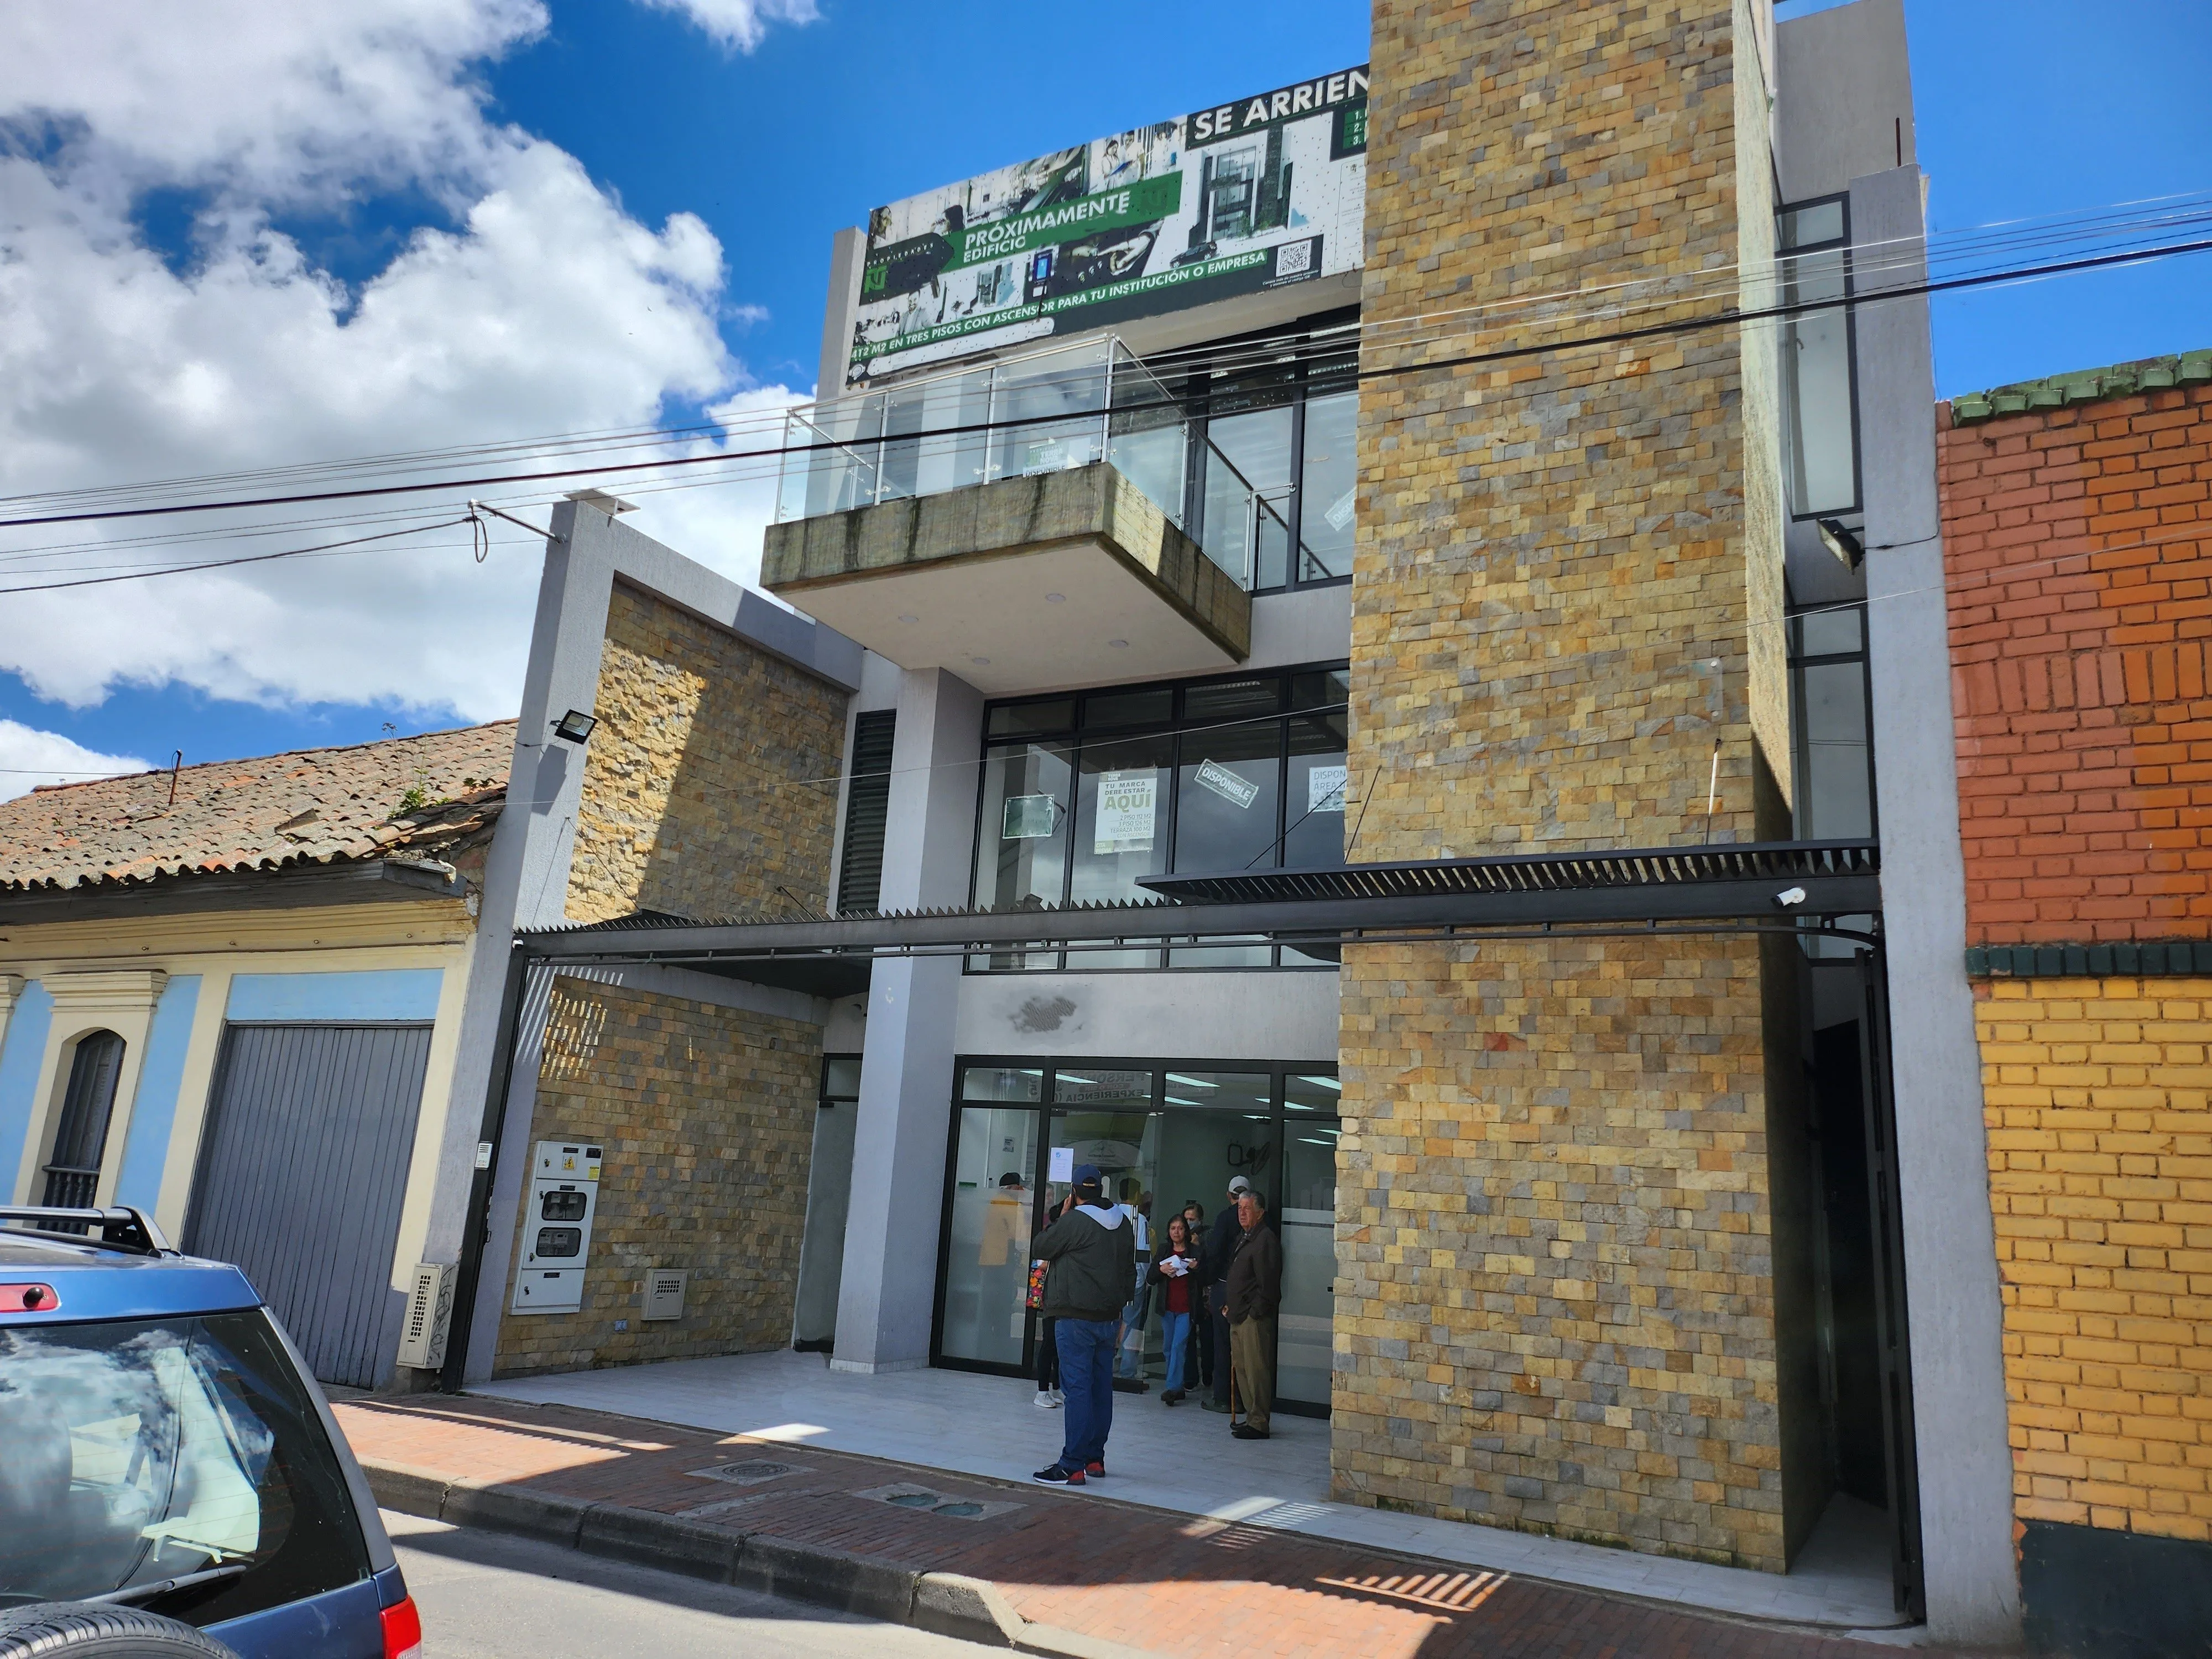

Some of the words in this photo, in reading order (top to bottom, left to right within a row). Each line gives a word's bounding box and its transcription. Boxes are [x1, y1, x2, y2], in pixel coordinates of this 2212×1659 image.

[1194, 106, 1232, 139] SE
[966, 191, 1130, 249] PRÓXIMAMENTE
[963, 236, 1026, 263] EDIFICIO
[889, 337, 903, 349] EN
[906, 332, 928, 345] TRES
[932, 323, 961, 338] PISOS
[964, 317, 990, 332] CON
[993, 302, 1055, 324] ASCENSOR
[1058, 294, 1087, 309] PARA
[1091, 289, 1106, 301] TU
[1109, 269, 1189, 297] INSTITUCIÓN
[1193, 265, 1203, 276] O
[1208, 252, 1265, 274] EMPRESA
[1202, 768, 1251, 800] DISPONIBLE
[1314, 780, 1336, 791] ÁREA
